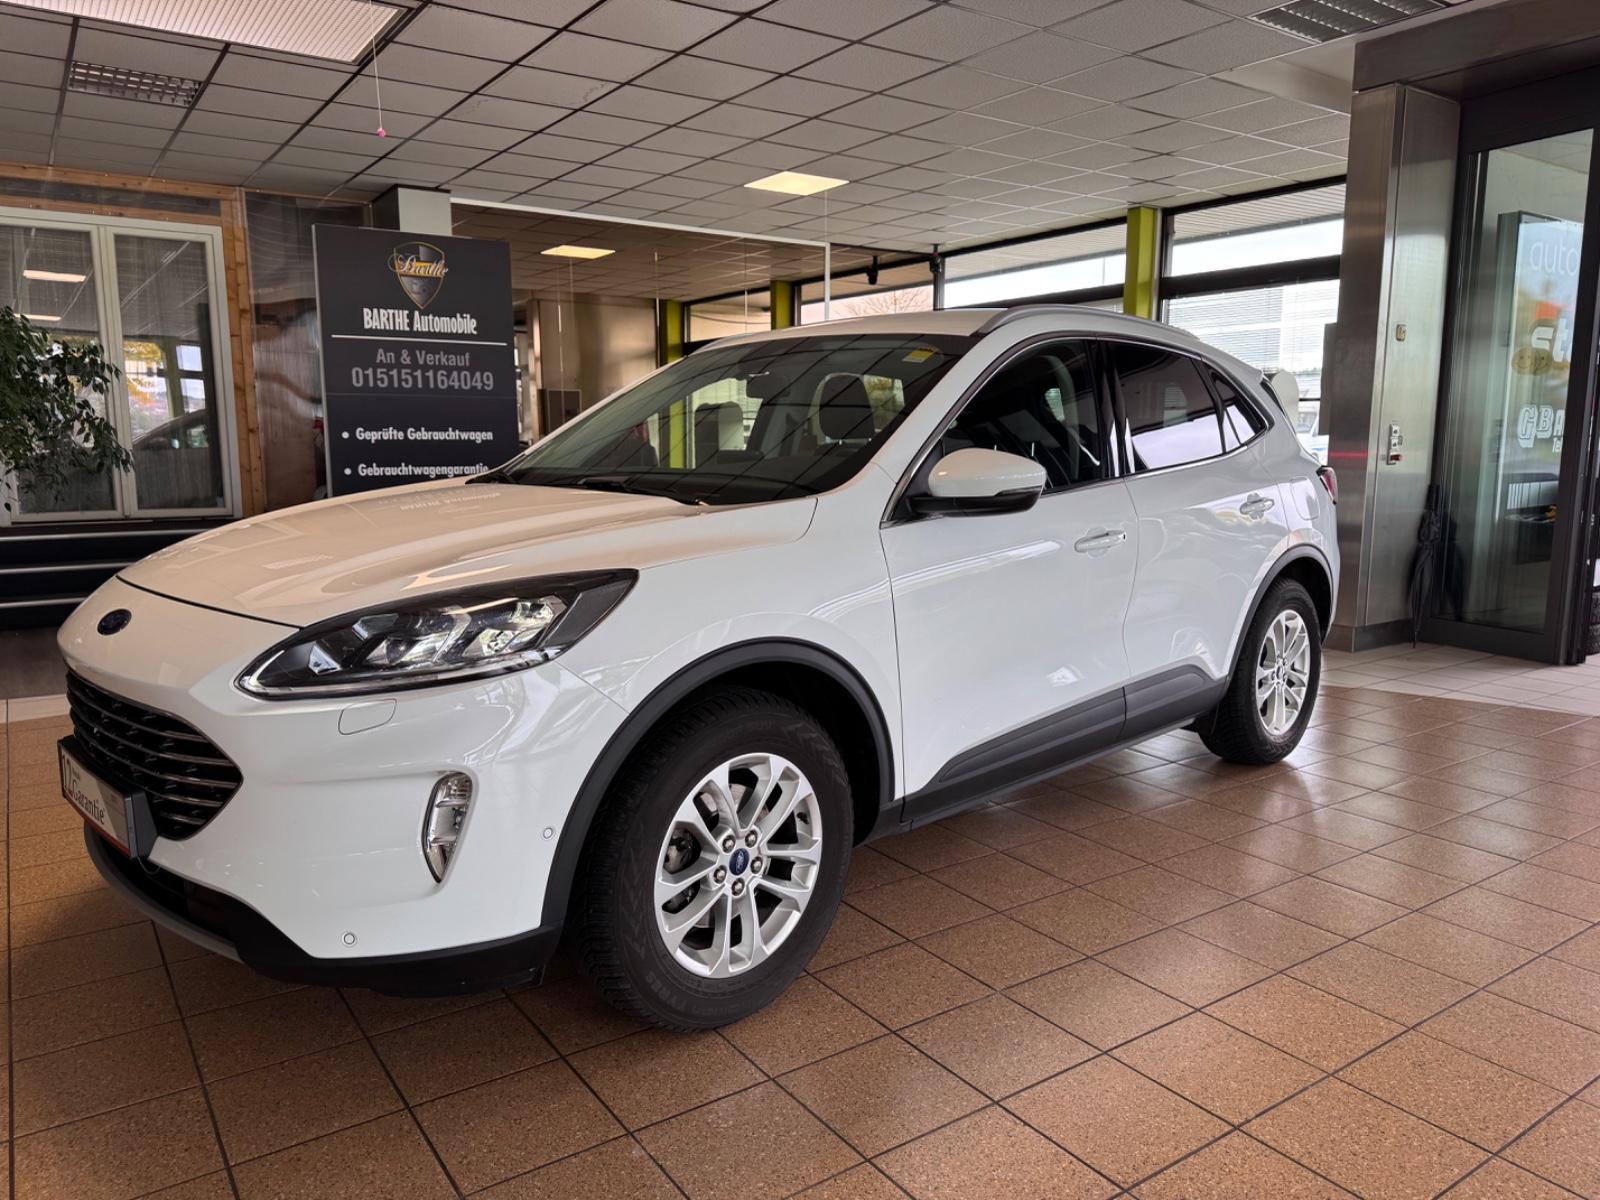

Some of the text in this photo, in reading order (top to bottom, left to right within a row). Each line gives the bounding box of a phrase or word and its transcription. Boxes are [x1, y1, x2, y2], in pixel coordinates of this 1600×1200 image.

[1530, 238, 1580, 276] auto
[363, 307, 477, 335] BARTHE Automobile
[376, 348, 470, 367] An & Verkauf
[351, 366, 494, 391] 015151164049
[355, 427, 493, 443] Geprüfte Gebrauchtwagen
[358, 462, 489, 478] Gebrauchtwagengarantie
